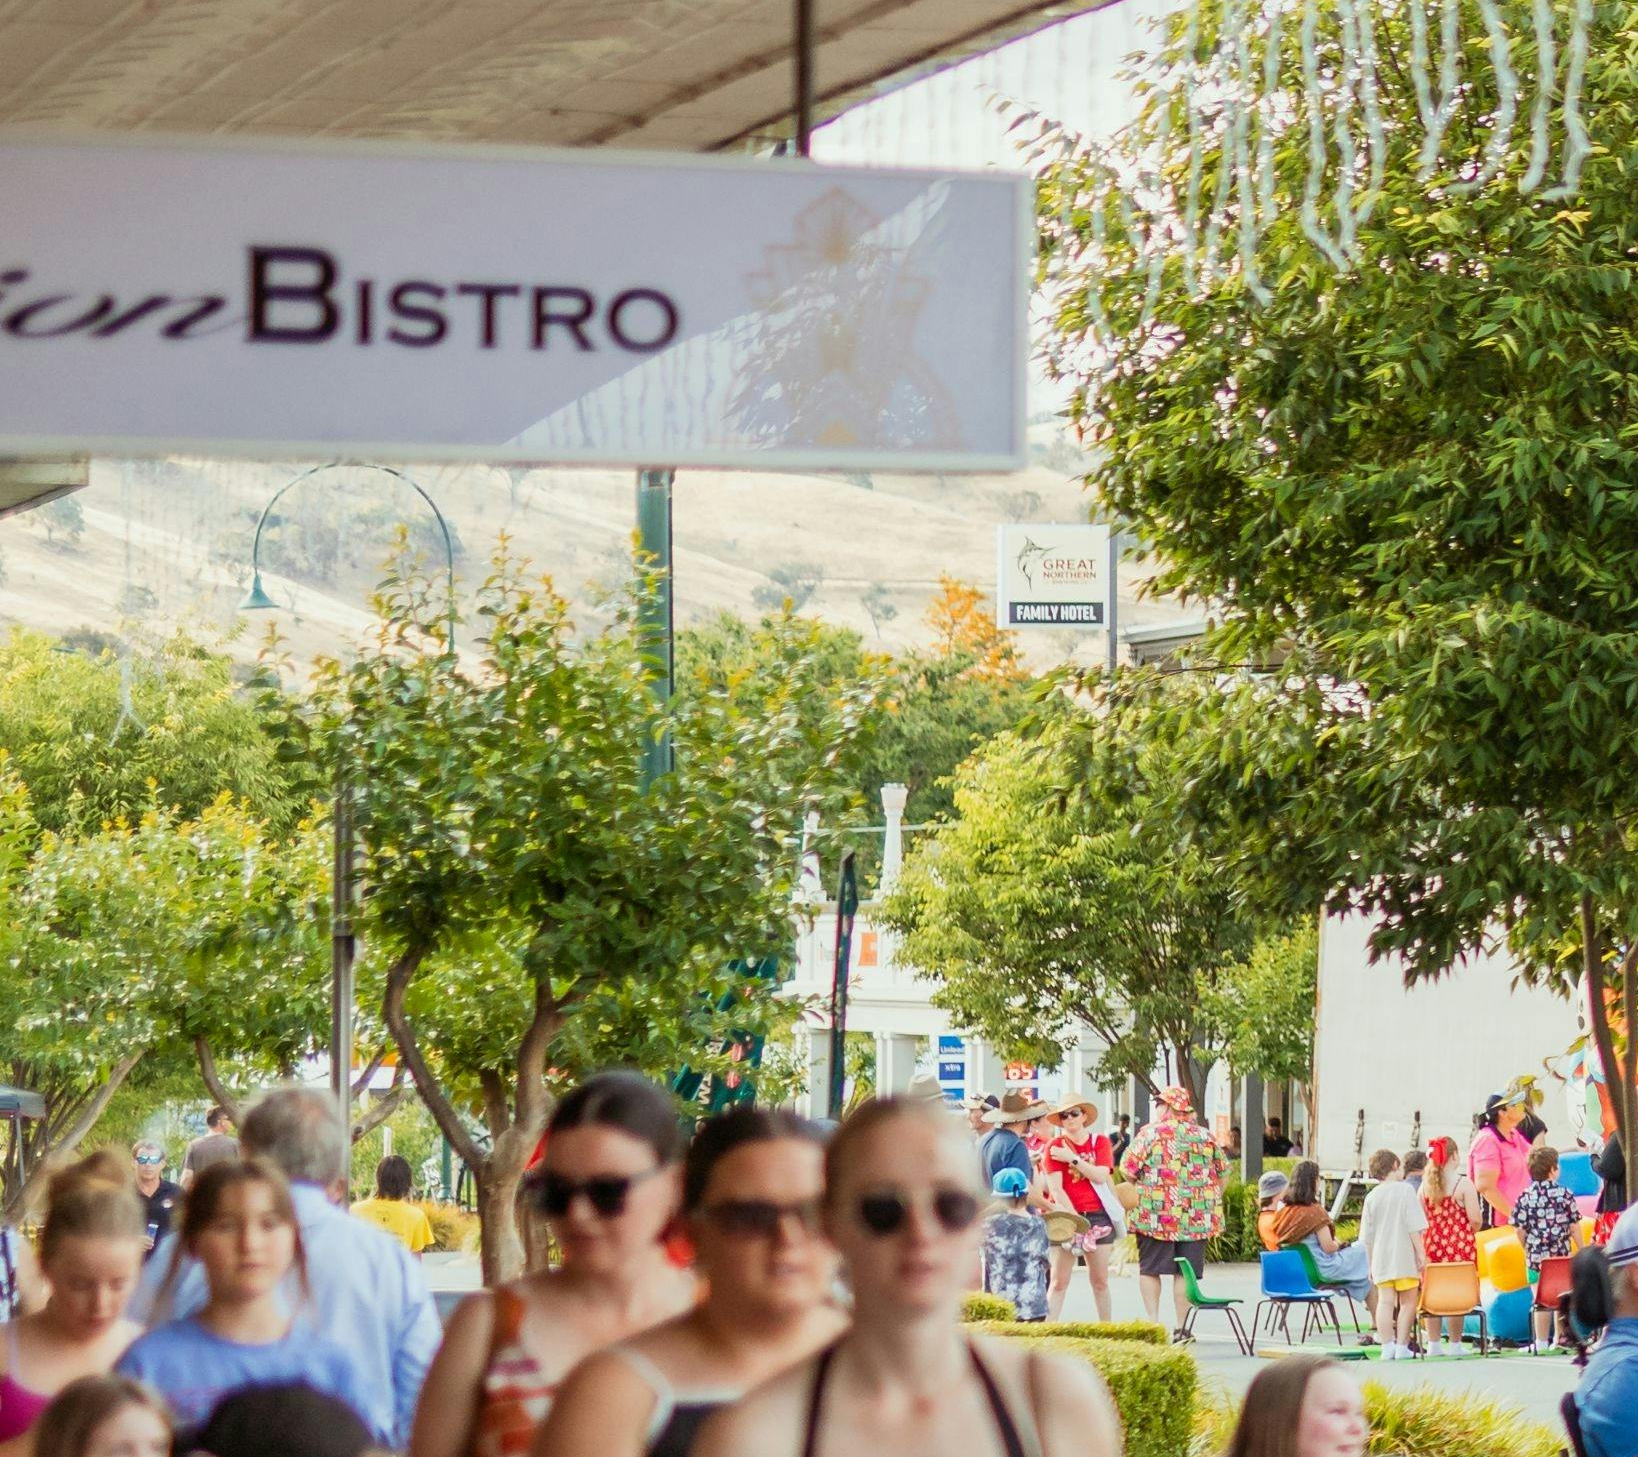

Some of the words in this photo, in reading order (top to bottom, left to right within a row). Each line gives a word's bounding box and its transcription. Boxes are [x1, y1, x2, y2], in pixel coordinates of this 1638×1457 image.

[0, 268, 228, 340] on
[244, 244, 680, 355] BISTRO
[1043, 558, 1097, 570] GREAT
[1042, 571, 1097, 579] NORTHERN
[1016, 604, 1059, 621] FAMILY
[1060, 604, 1097, 621] HOTEL
